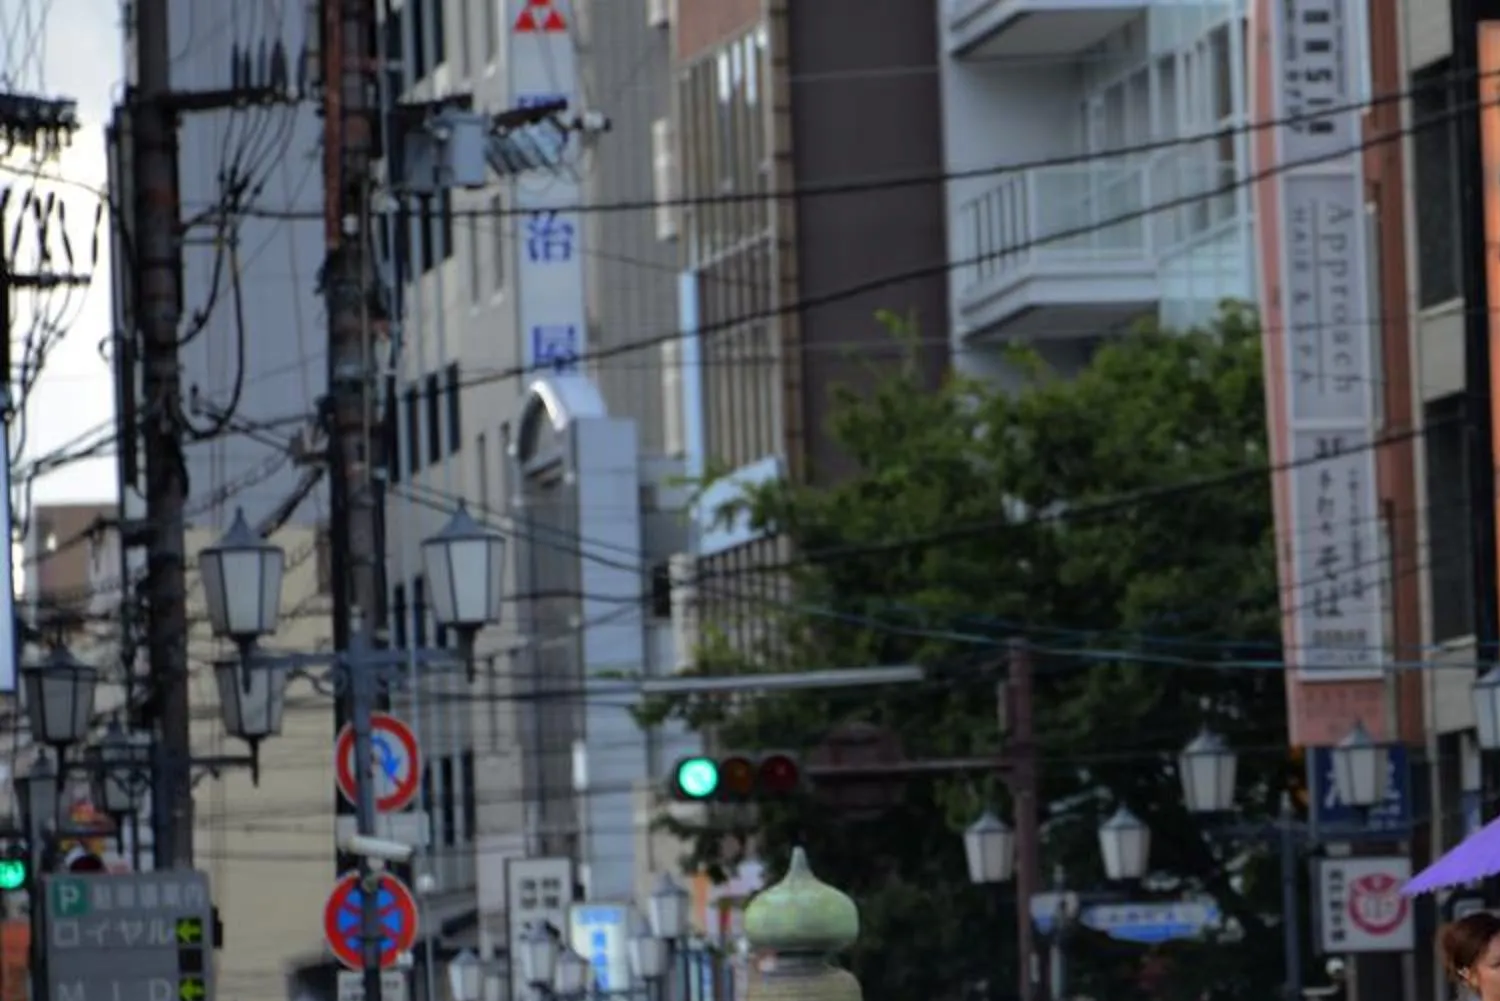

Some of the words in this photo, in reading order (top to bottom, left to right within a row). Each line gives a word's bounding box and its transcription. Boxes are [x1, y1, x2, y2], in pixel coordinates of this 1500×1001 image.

[59, 883, 81, 912] P
[53, 918, 174, 946] ロイヤル
